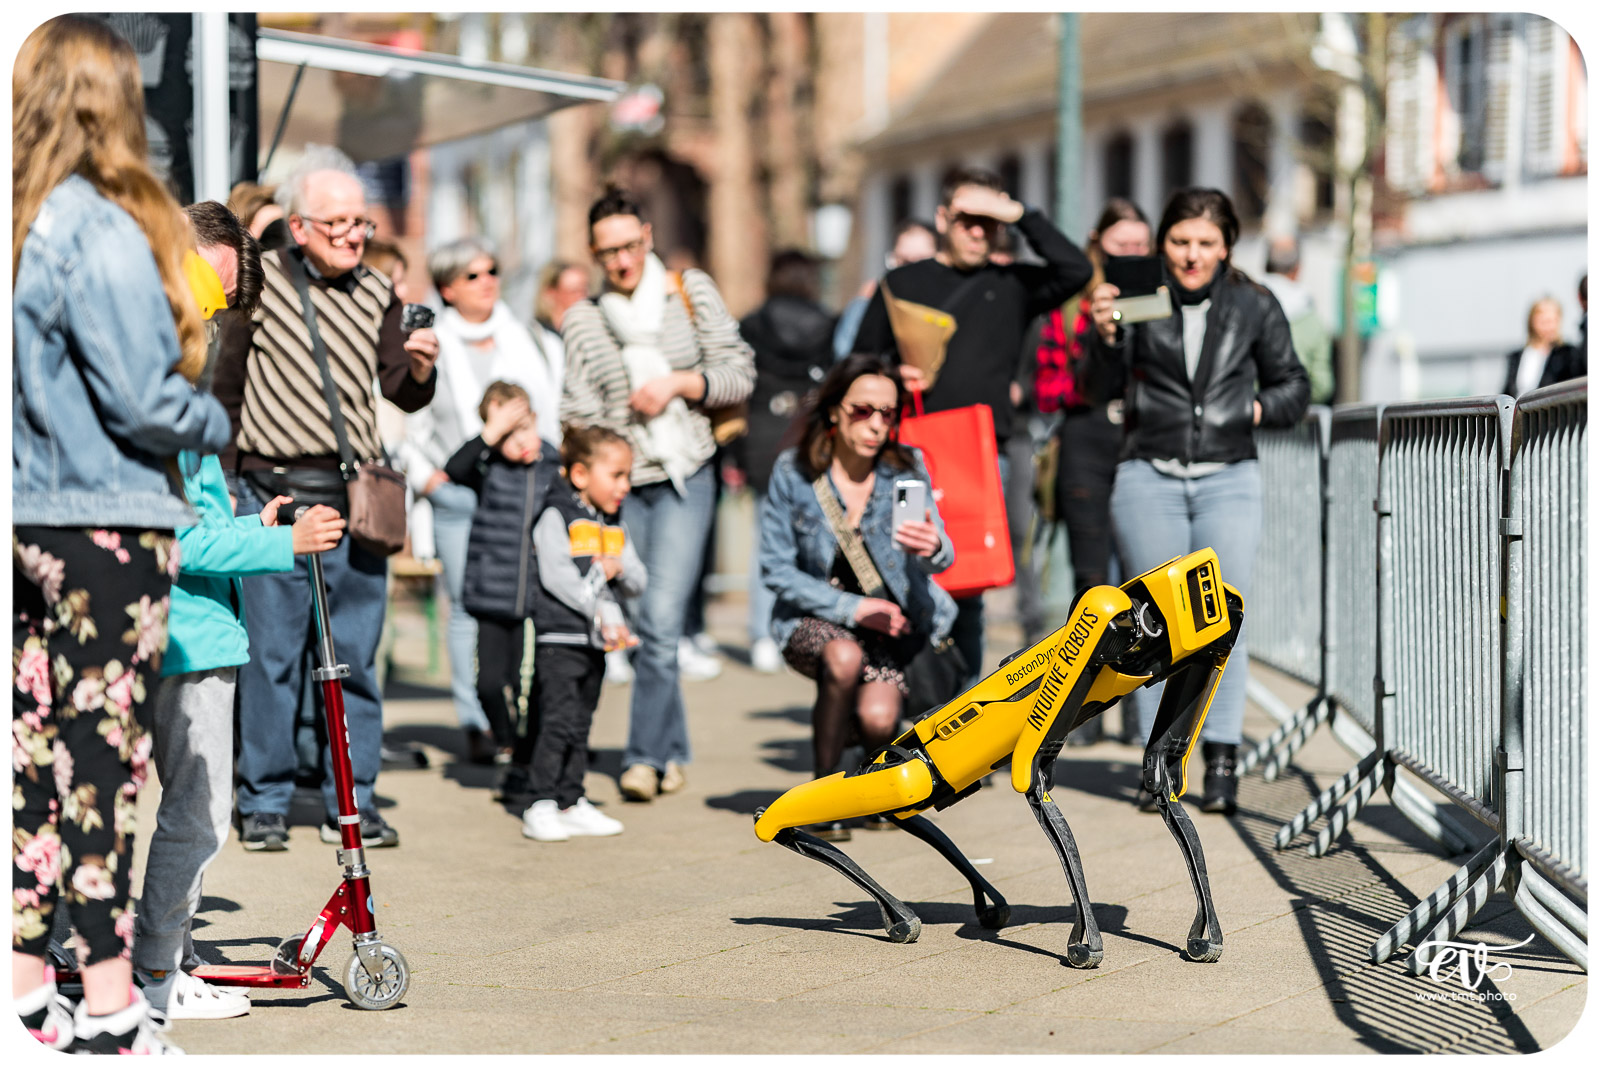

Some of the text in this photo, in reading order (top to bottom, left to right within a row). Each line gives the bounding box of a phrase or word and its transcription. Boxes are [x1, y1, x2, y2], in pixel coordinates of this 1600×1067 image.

[1005, 644, 1058, 686] BostonDyn
[1027, 606, 1099, 732] INTUITIVE ROBOTS
